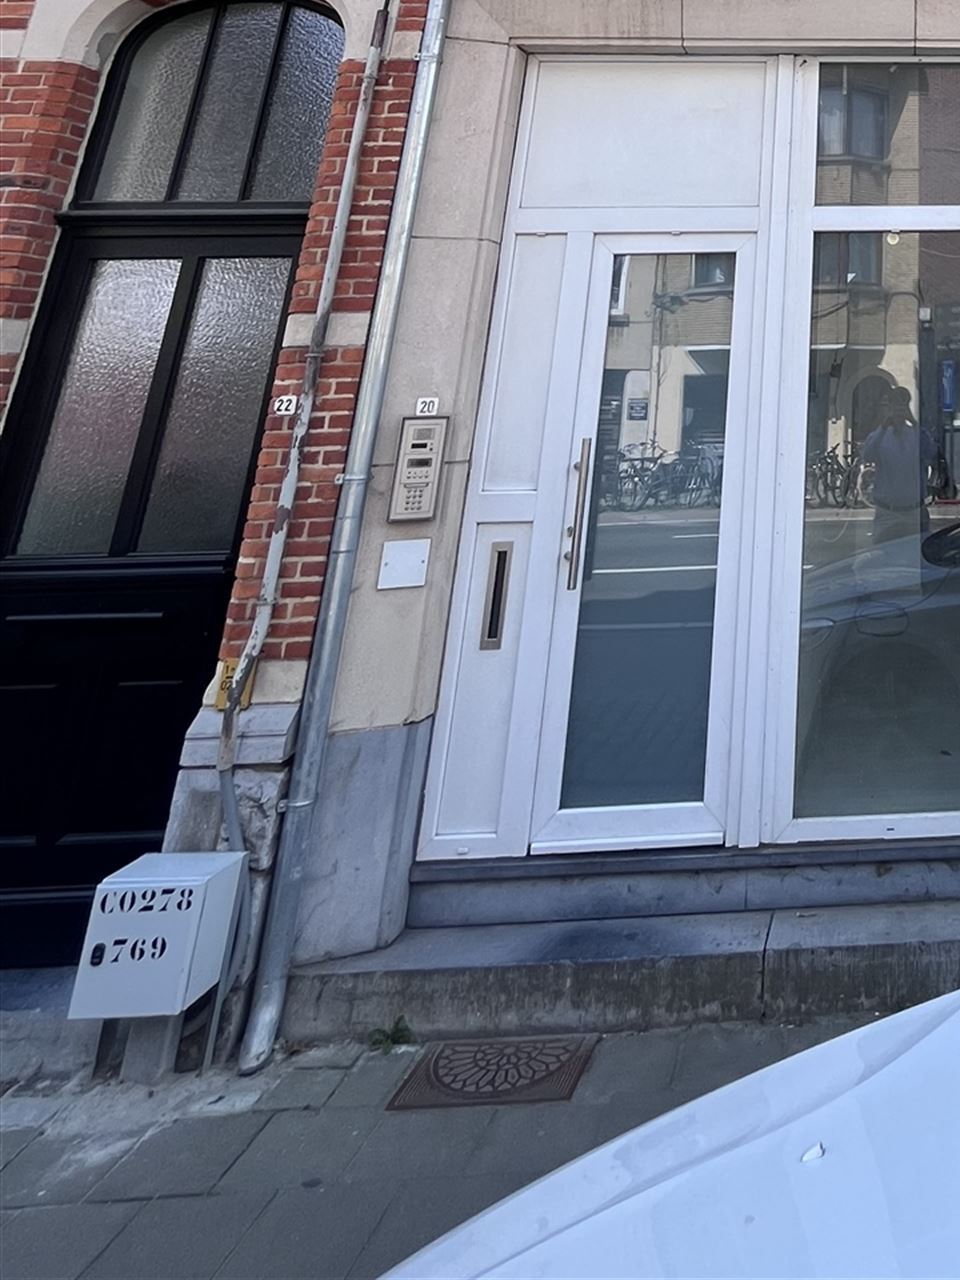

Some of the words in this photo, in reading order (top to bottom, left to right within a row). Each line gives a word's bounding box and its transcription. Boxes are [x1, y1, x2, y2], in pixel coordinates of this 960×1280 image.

[275, 398, 293, 413] 22
[419, 400, 435, 414] 20
[110, 936, 168, 964] 769
